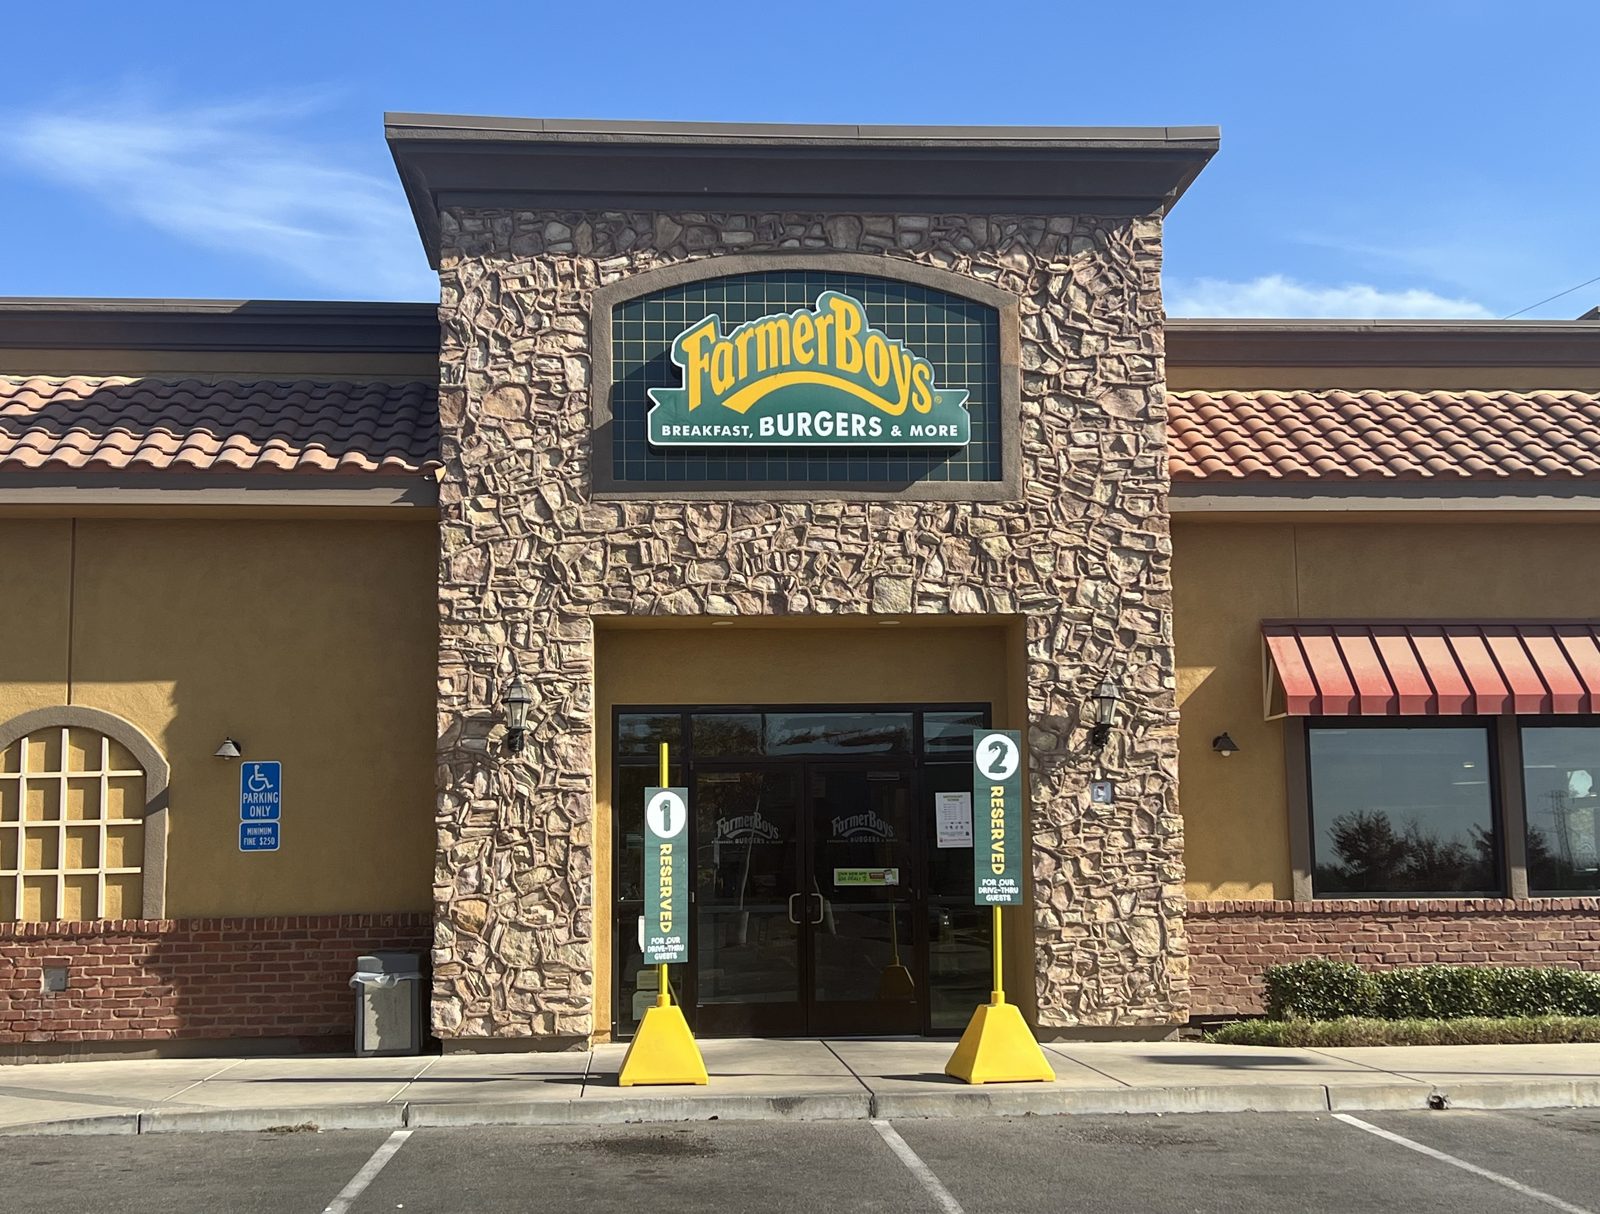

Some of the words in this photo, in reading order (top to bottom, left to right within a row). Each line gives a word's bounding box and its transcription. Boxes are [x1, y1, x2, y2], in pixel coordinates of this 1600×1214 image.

[661, 424, 754, 439] BREAKFAST,
[759, 411, 882, 438] BURGERS
[890, 425, 902, 437] &
[909, 424, 958, 437] MORE
[988, 740, 1008, 774] 2
[243, 792, 278, 803] PARKING
[249, 806, 270, 816] ONLY
[659, 799, 670, 831] 1
[247, 827, 271, 835] MINIMUM
[990, 785, 1004, 874] RESERVED
[243, 837, 255, 845] FINE
[259, 837, 274, 845] $250
[659, 843, 672, 932] RESERVED
[654, 952, 677, 960] GUESTS
